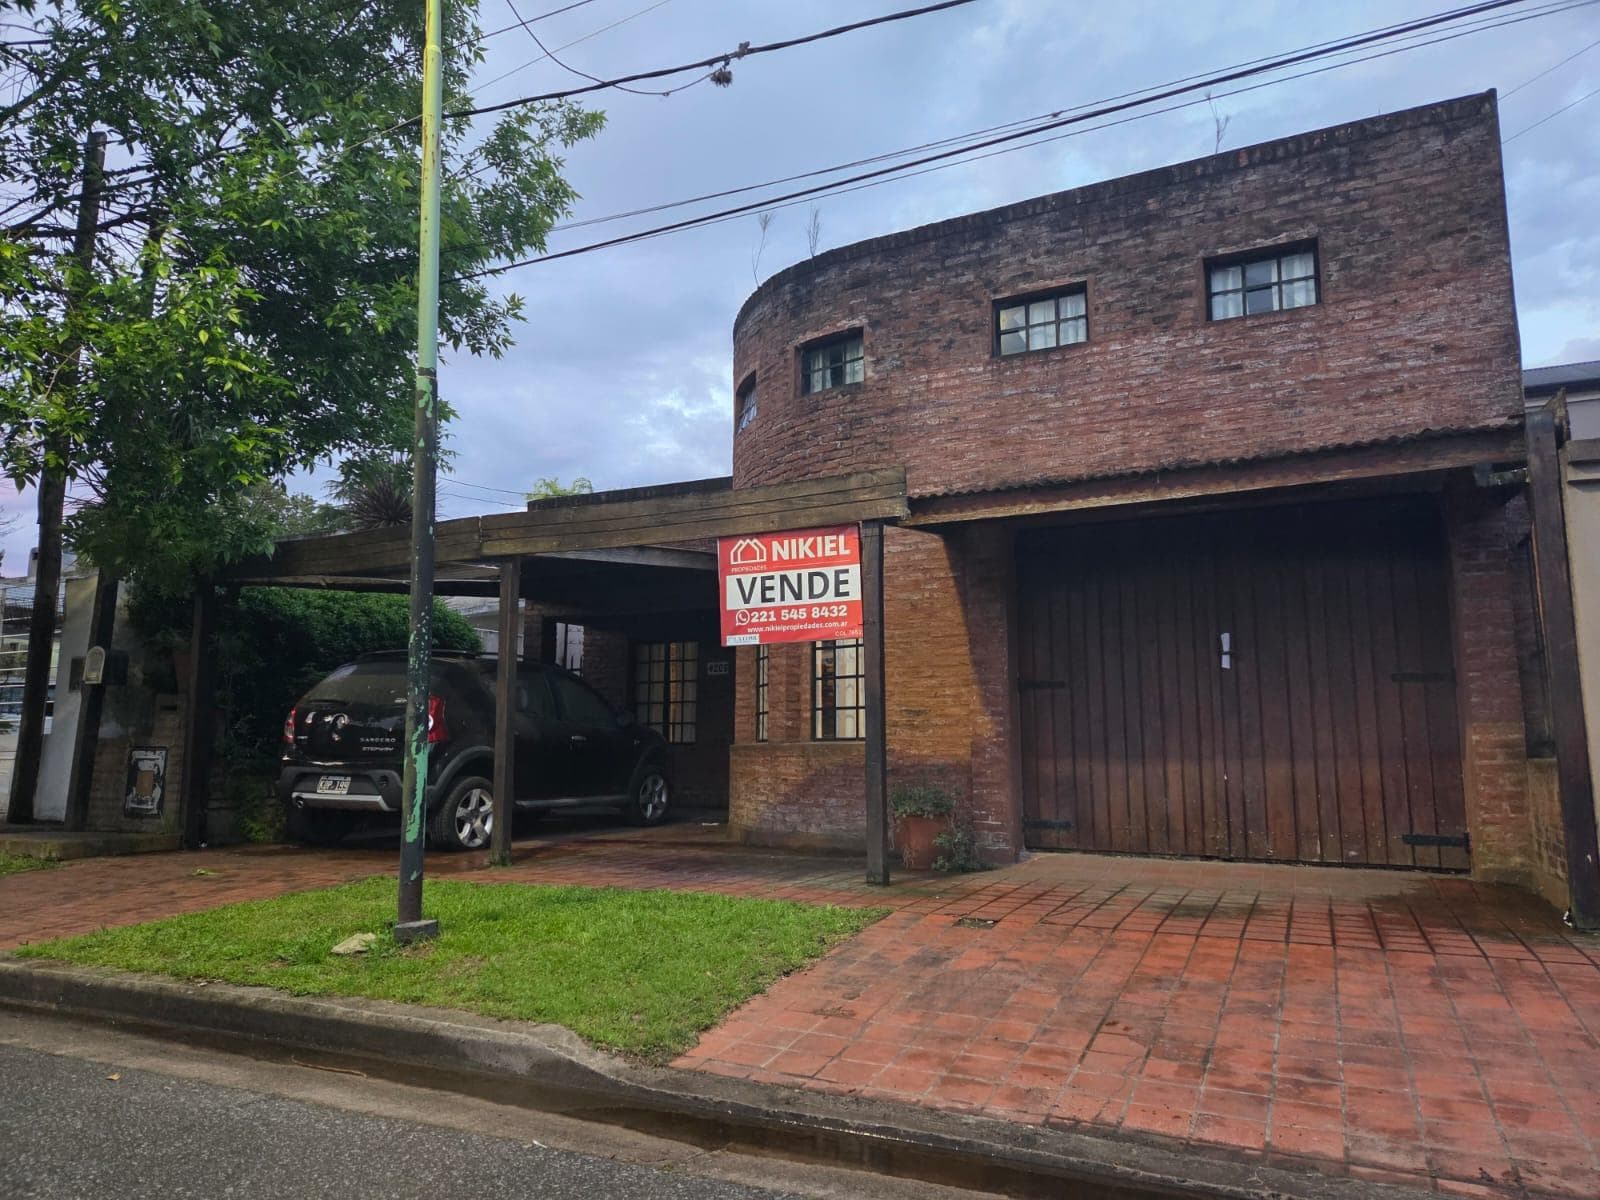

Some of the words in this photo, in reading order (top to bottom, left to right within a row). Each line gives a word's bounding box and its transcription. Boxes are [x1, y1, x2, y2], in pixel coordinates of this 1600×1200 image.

[771, 534, 851, 562] NIKIEL
[736, 568, 850, 605] VENDE
[751, 610, 777, 623] 221
[781, 608, 807, 621] 545
[811, 605, 847, 618] 8432
[747, 621, 849, 633] www.nikielpropiedades.com.ar
